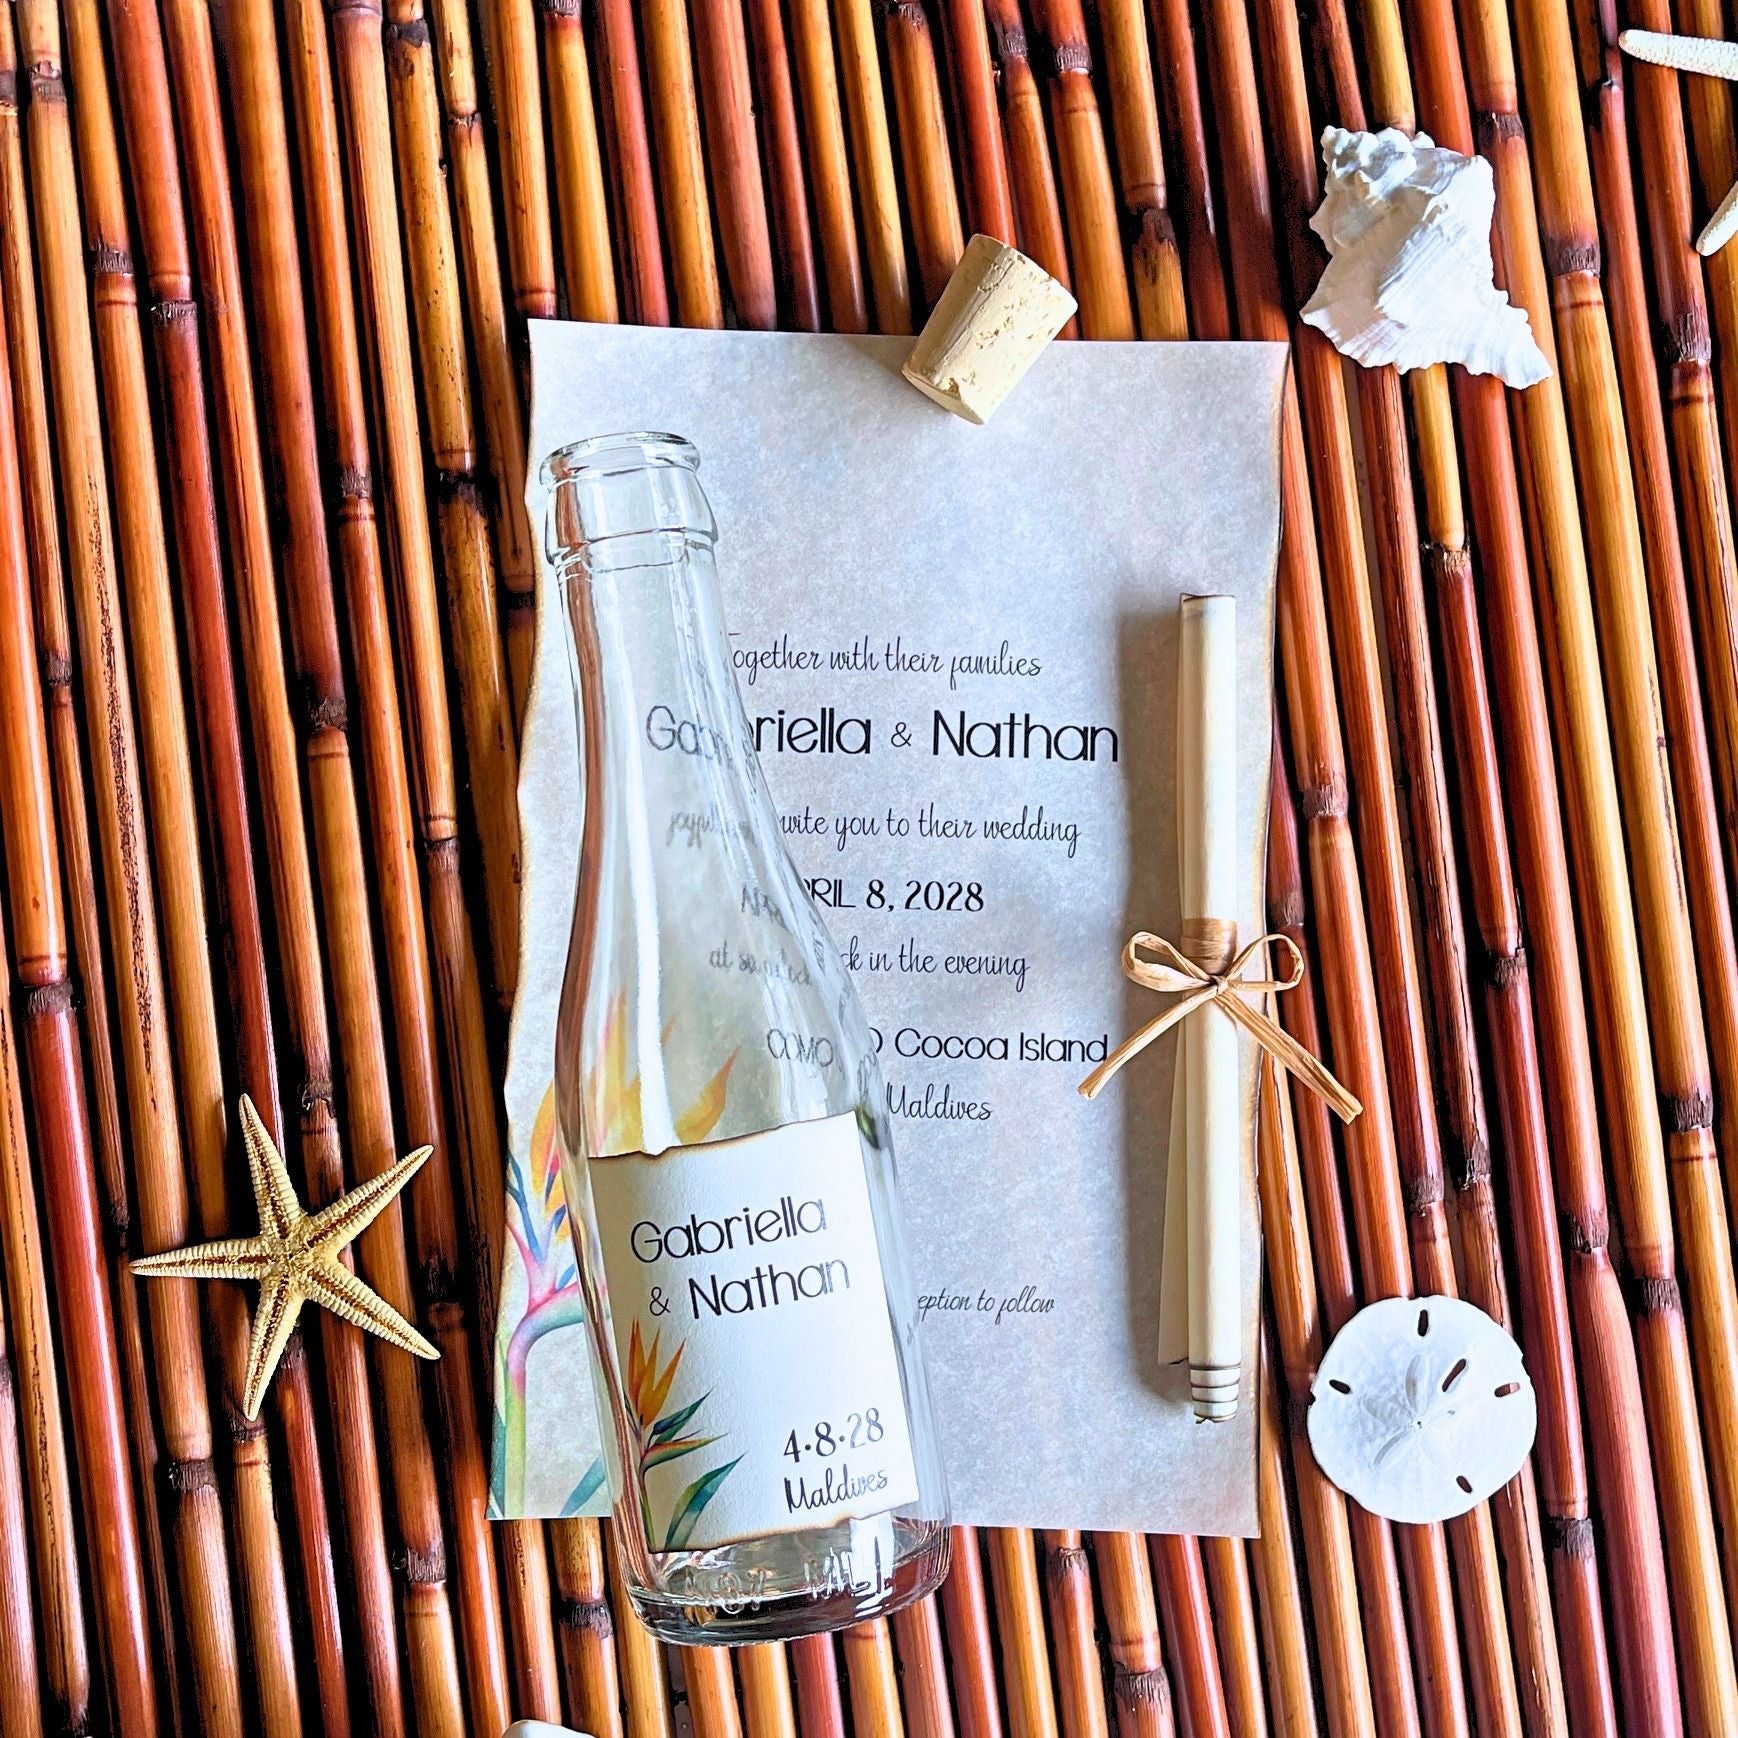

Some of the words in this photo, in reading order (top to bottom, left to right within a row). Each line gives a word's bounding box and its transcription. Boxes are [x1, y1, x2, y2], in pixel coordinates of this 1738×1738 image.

[728, 632, 823, 686] ogether
[830, 635, 879, 671] with
[884, 636, 944, 673] their
[949, 639, 1042, 690] families
[890, 721, 912, 748] &
[932, 709, 1119, 763] Nathan
[781, 805, 829, 835] vite
[835, 816, 880, 851] you
[886, 807, 910, 837] to
[918, 801, 977, 839] their
[983, 805, 1081, 858] wedding
[865, 879, 895, 913] 8,
[904, 880, 984, 913] 2028
[869, 950, 893, 972] in
[898, 937, 938, 974] the
[944, 955, 1030, 993] evening
[894, 1027, 1009, 1060] Cocoa
[1019, 1031, 1109, 1063] Island
[886, 1082, 993, 1121] Maldives
[630, 1196, 827, 1263] Gabriella
[649, 1285, 671, 1317] &
[687, 1257, 851, 1320] Nathan
[917, 1287, 971, 1322] eption
[976, 1288, 995, 1312] to
[994, 1285, 1055, 1325] follow
[783, 1464, 889, 1514] Maldives
